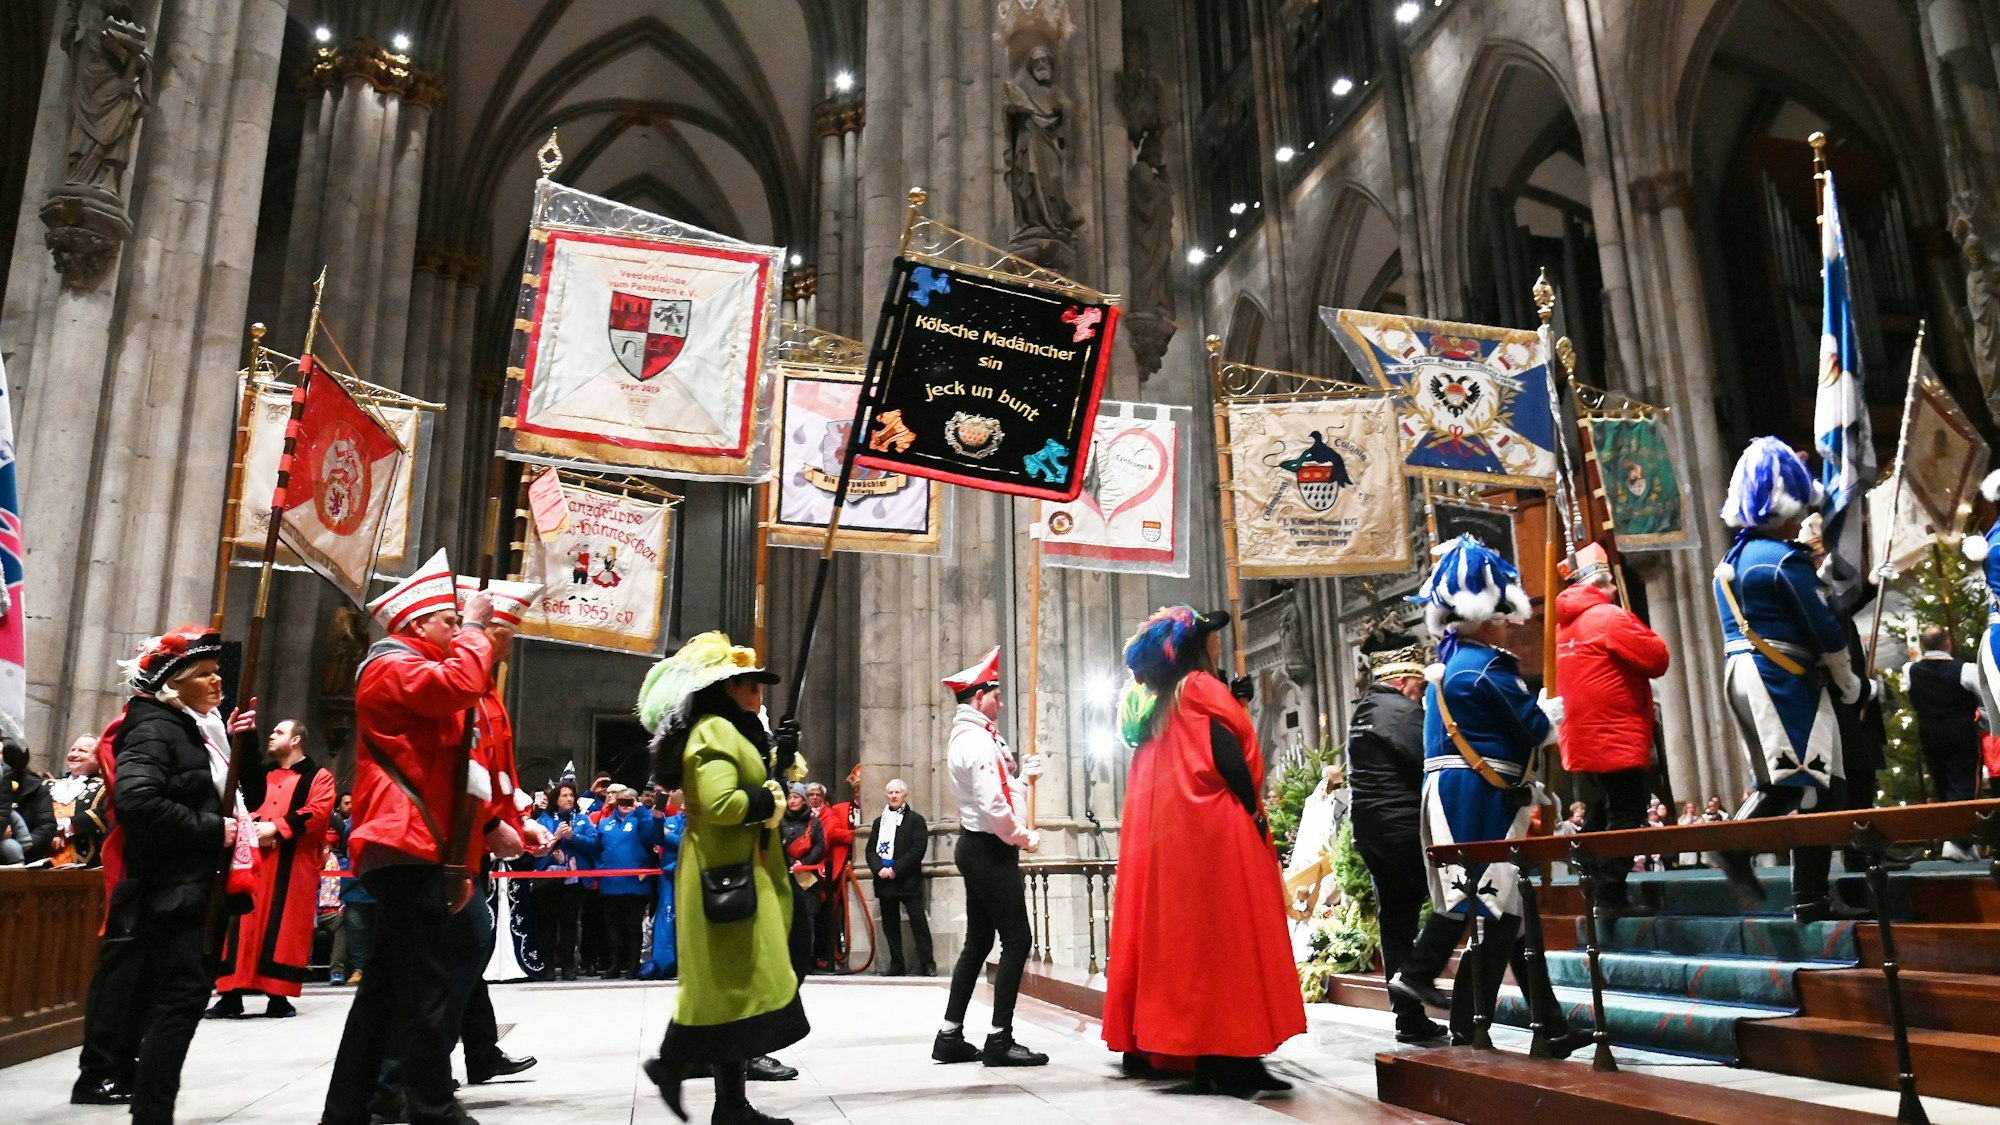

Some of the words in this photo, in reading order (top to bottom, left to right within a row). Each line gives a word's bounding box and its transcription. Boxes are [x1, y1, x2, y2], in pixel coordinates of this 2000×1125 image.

[914, 314, 979, 341] Kölsche
[982, 330, 1077, 362] Madämcher
[978, 355, 1004, 371] sin
[924, 380, 966, 403] jeck
[971, 383, 994, 400] un
[997, 388, 1040, 423] bunt
[564, 495, 644, 525] anzgruppe
[578, 603, 609, 621] 1955
